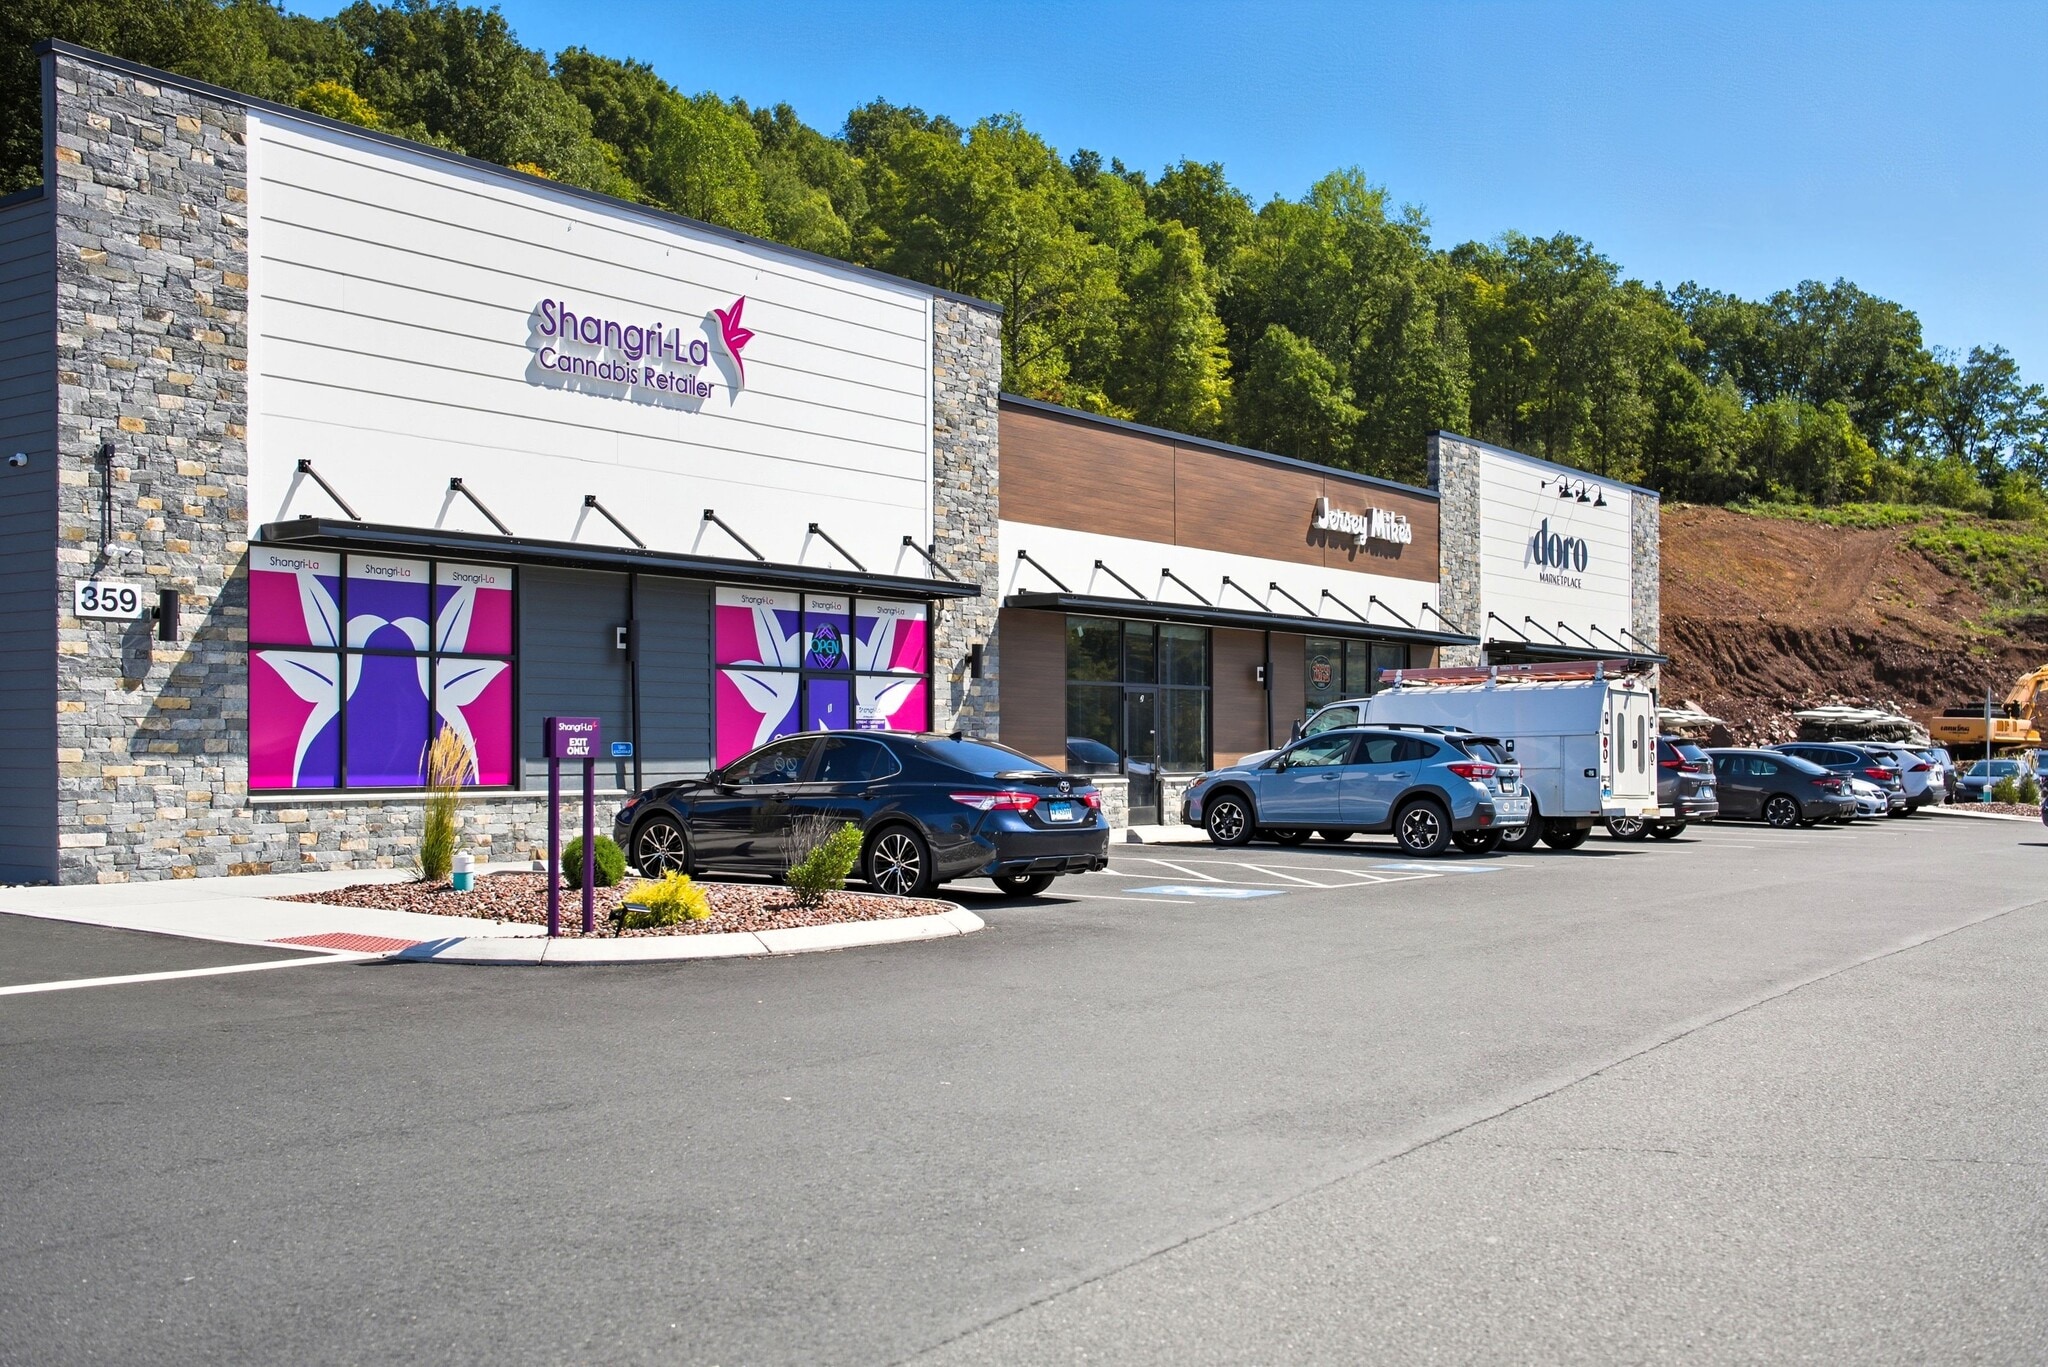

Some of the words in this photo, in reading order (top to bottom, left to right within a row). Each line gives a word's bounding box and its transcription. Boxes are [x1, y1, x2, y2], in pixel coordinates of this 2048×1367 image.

[539, 298, 708, 367] Shangri-La
[539, 346, 638, 385] Cannabis
[644, 366, 715, 399] Retailer
[1312, 497, 1368, 546] Jersey
[1533, 516, 1588, 573] doro
[269, 556, 320, 571] Shangri-La
[365, 563, 411, 578] Shangri-La
[452, 571, 495, 585] Shangri-La
[1539, 572, 1582, 589] MARKETPLACE
[81, 586, 137, 613] 359
[741, 594, 774, 606] Shangri-La
[811, 600, 842, 611] Shangri-La
[877, 606, 905, 616] Shangri-La
[811, 638, 840, 655] OPEN
[558, 722, 593, 732] Shangri-La
[569, 738, 588, 746] EXIT
[566, 746, 590, 755] ONLY
